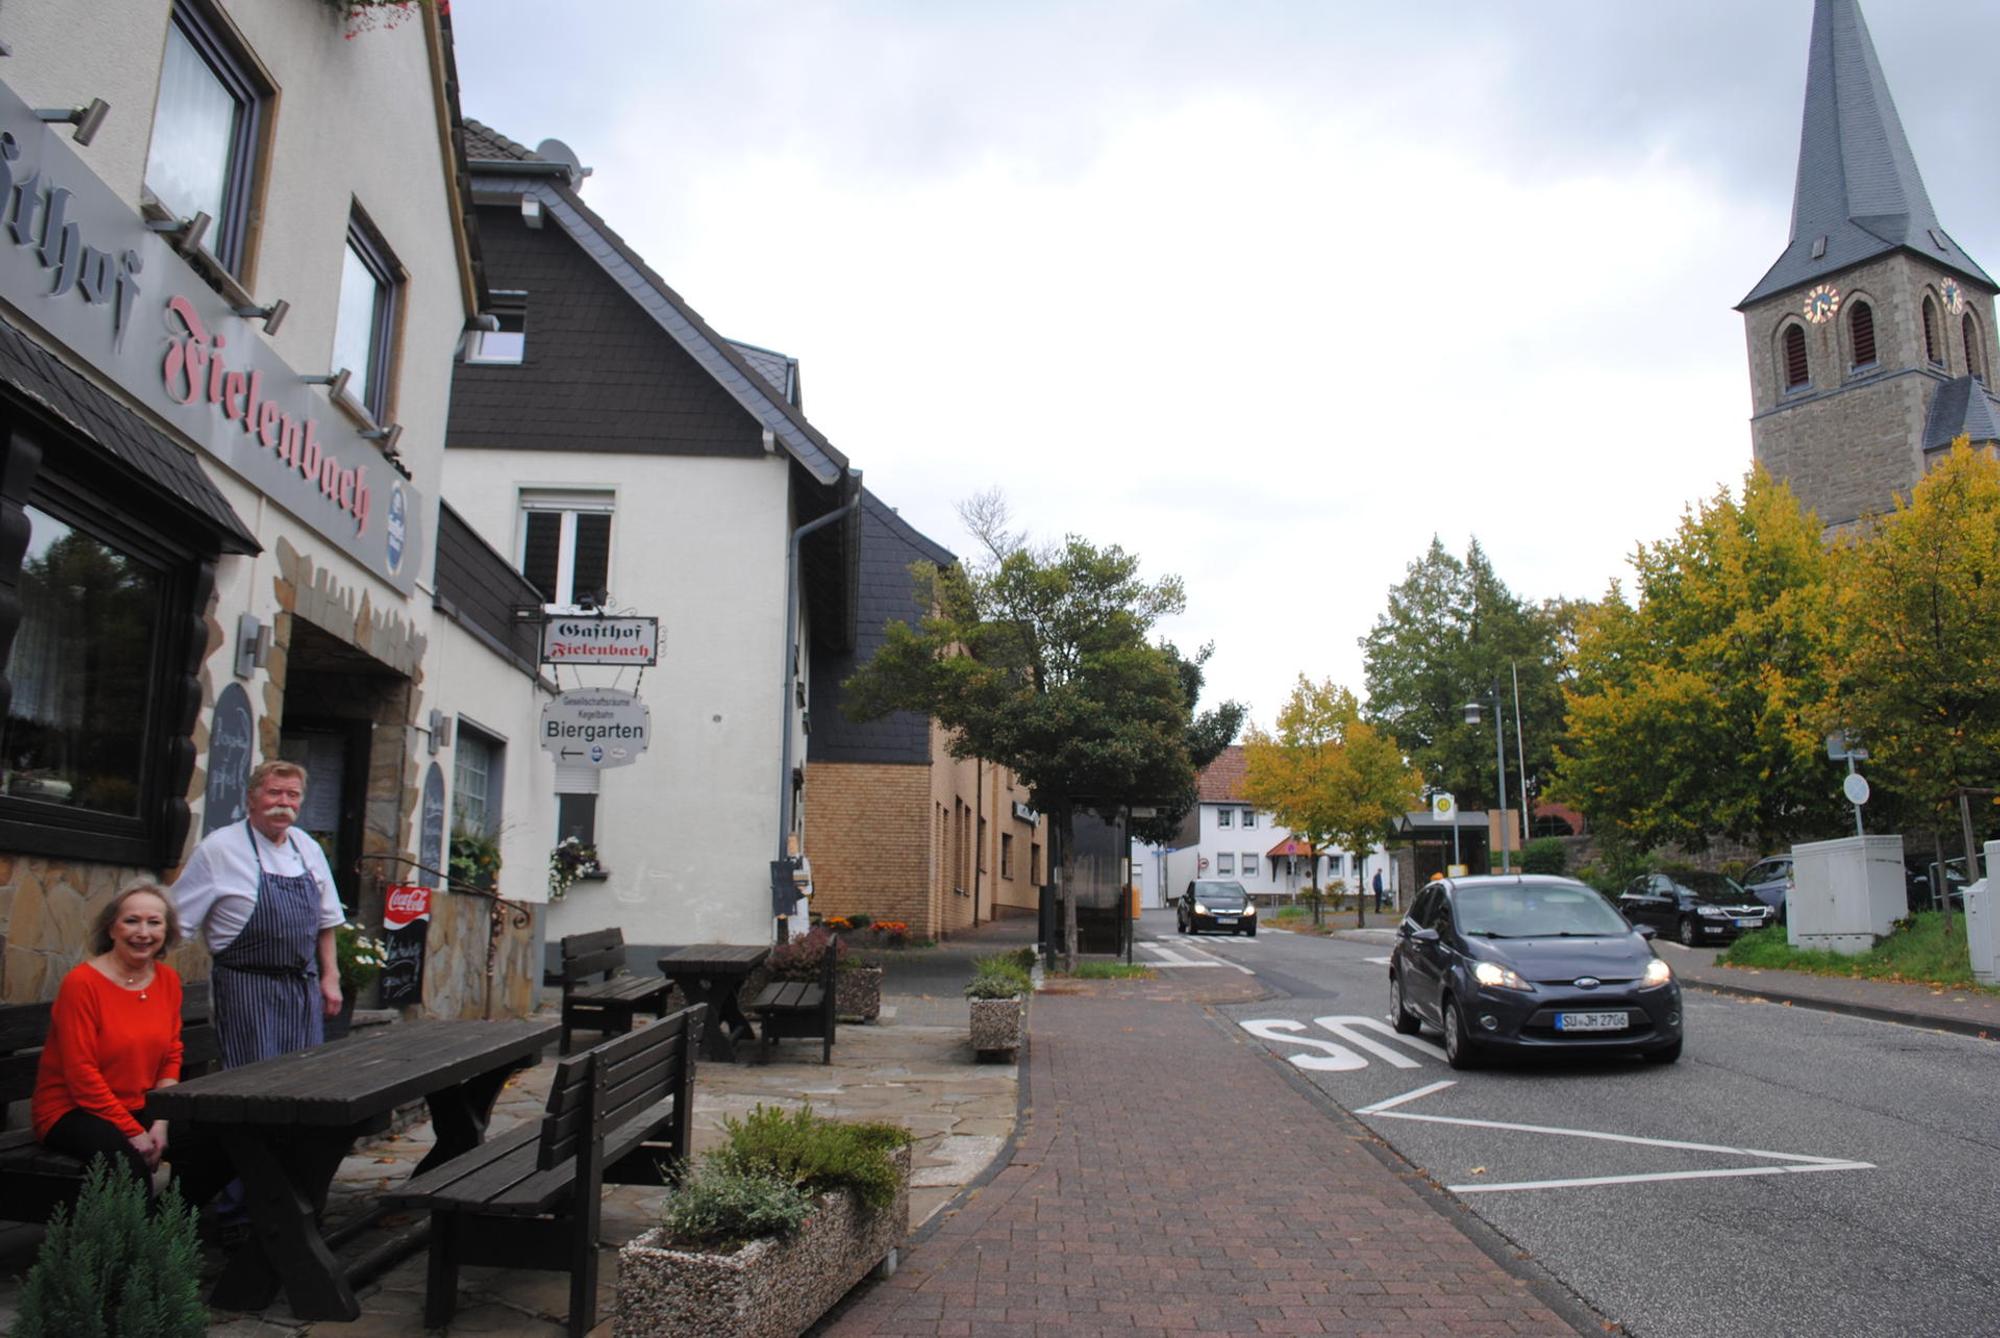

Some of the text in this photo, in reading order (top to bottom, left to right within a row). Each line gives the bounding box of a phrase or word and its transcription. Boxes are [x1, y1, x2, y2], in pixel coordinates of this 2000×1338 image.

[551, 642, 649, 657] Fielenbach
[547, 721, 643, 742] Biergarten
[1239, 1014, 1450, 1071] US
